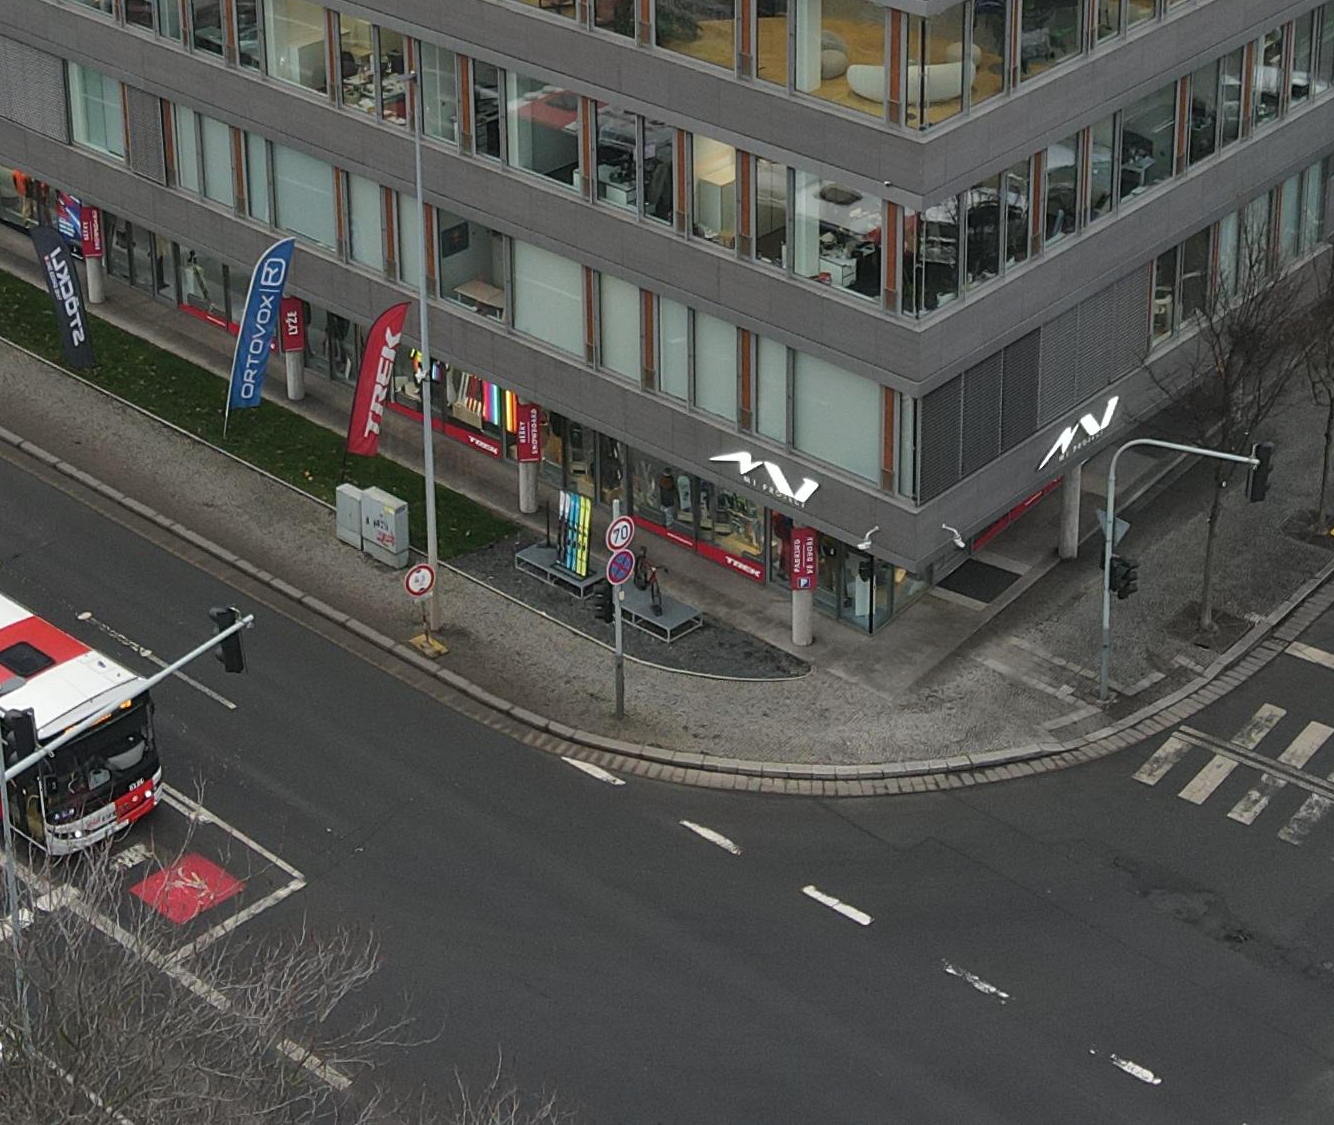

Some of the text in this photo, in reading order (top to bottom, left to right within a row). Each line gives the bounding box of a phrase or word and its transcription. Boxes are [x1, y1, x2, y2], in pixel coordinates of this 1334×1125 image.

[285, 310, 299, 336] LYŽE
[240, 294, 275, 400] ORTOVOX
[364, 326, 402, 438] TREK
[468, 435, 499, 455] TREK
[613, 524, 628, 543] 70
[725, 555, 762, 579] TREK
